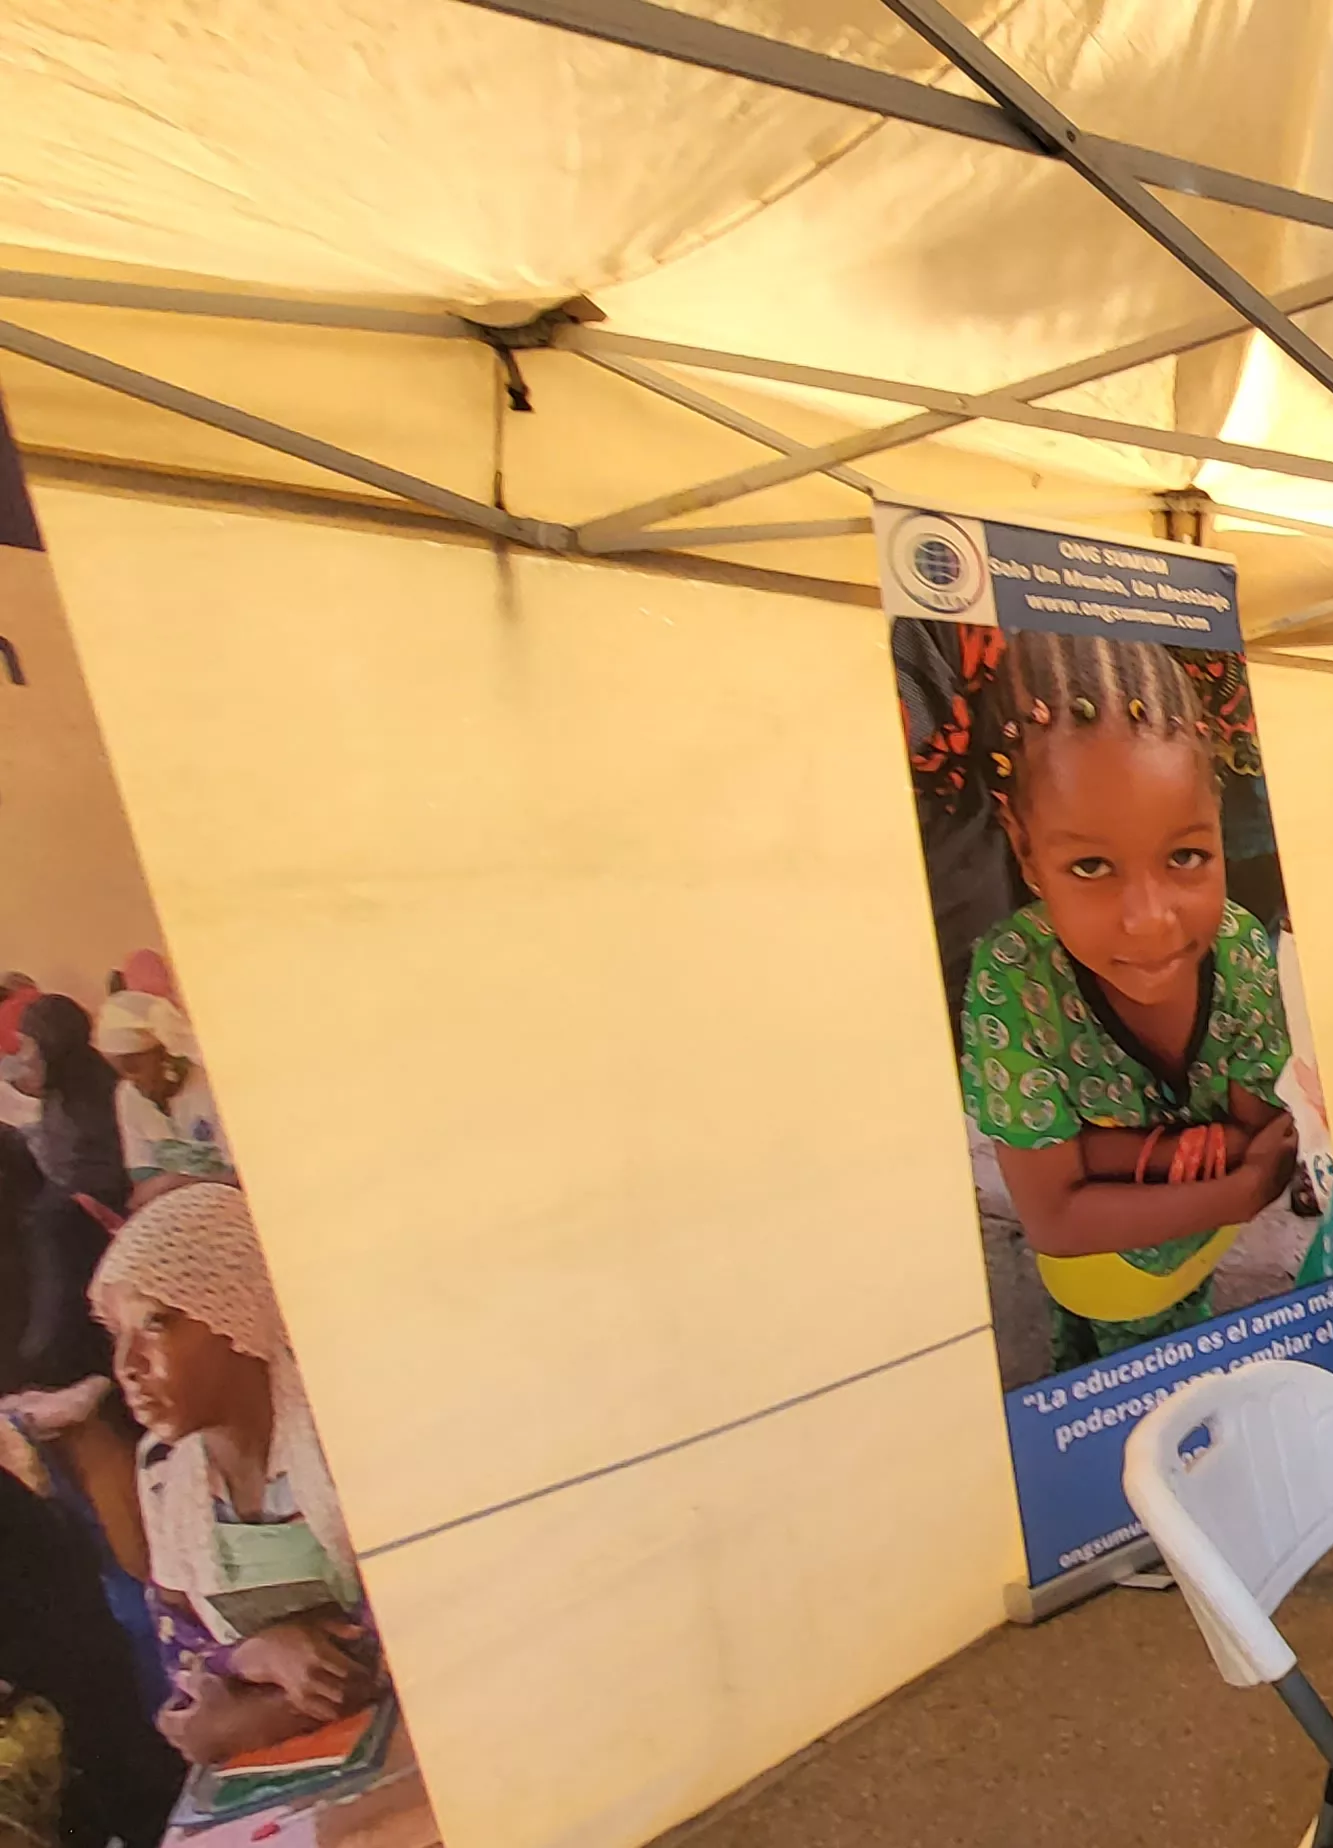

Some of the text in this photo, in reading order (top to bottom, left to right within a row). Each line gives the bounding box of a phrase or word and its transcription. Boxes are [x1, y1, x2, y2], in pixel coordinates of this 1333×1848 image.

[1059, 540, 1101, 564] ONG
[988, 556, 1031, 580] Solo
[1032, 563, 1061, 585] Un
[1131, 578, 1157, 599] Un
[1071, 1340, 1194, 1401] educación
[1197, 1330, 1222, 1354] es
[1226, 1318, 1248, 1343] el
[1252, 1302, 1305, 1334] arma
[1059, 1521, 1146, 1568] ongsumu
